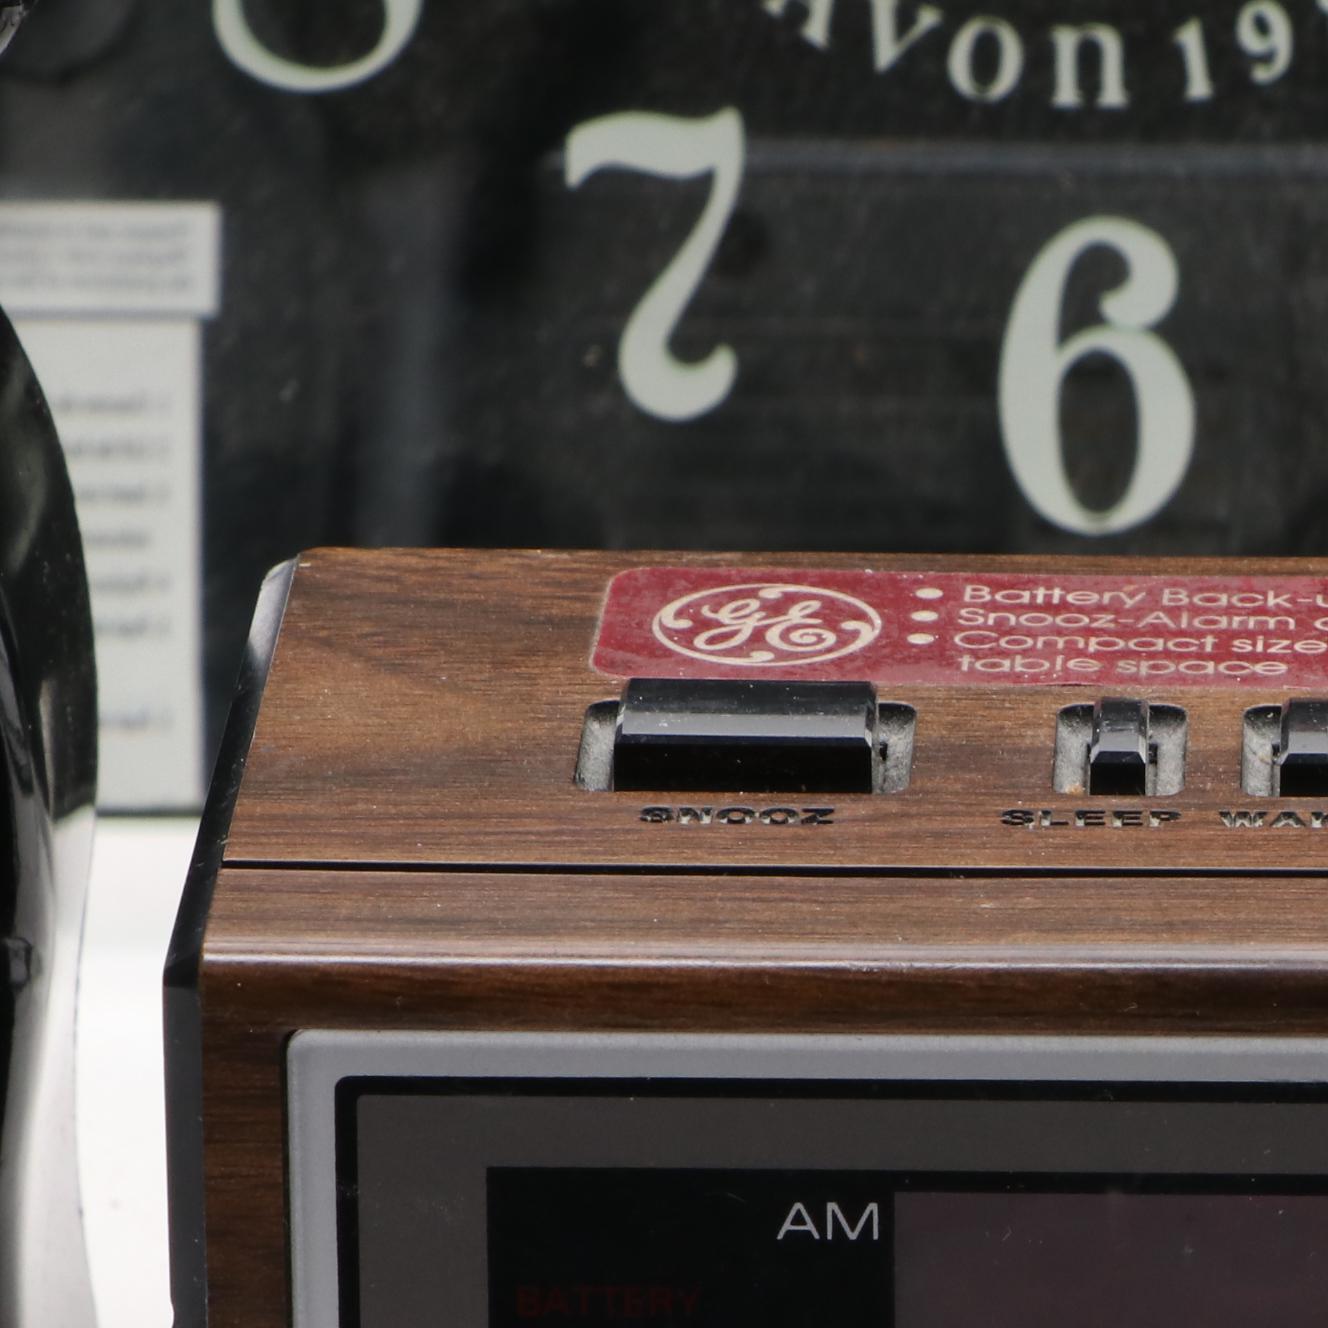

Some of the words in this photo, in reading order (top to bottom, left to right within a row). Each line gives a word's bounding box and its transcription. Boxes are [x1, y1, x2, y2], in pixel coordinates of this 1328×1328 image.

[565, 107, 745, 421] 7
[998, 215, 1197, 536] 6
[962, 584, 1147, 609] Battery
[957, 607, 1297, 632] Snooz-Alarm
[953, 630, 1213, 655] Compact
[1231, 635, 1328, 655] size
[957, 654, 1102, 676] table
[1113, 660, 1289, 679] space
[639, 805, 836, 826] SNOOZ
[1001, 809, 1184, 828] SLEEP
[776, 1202, 880, 1241] AM
[515, 1286, 700, 1318] BATTERY
